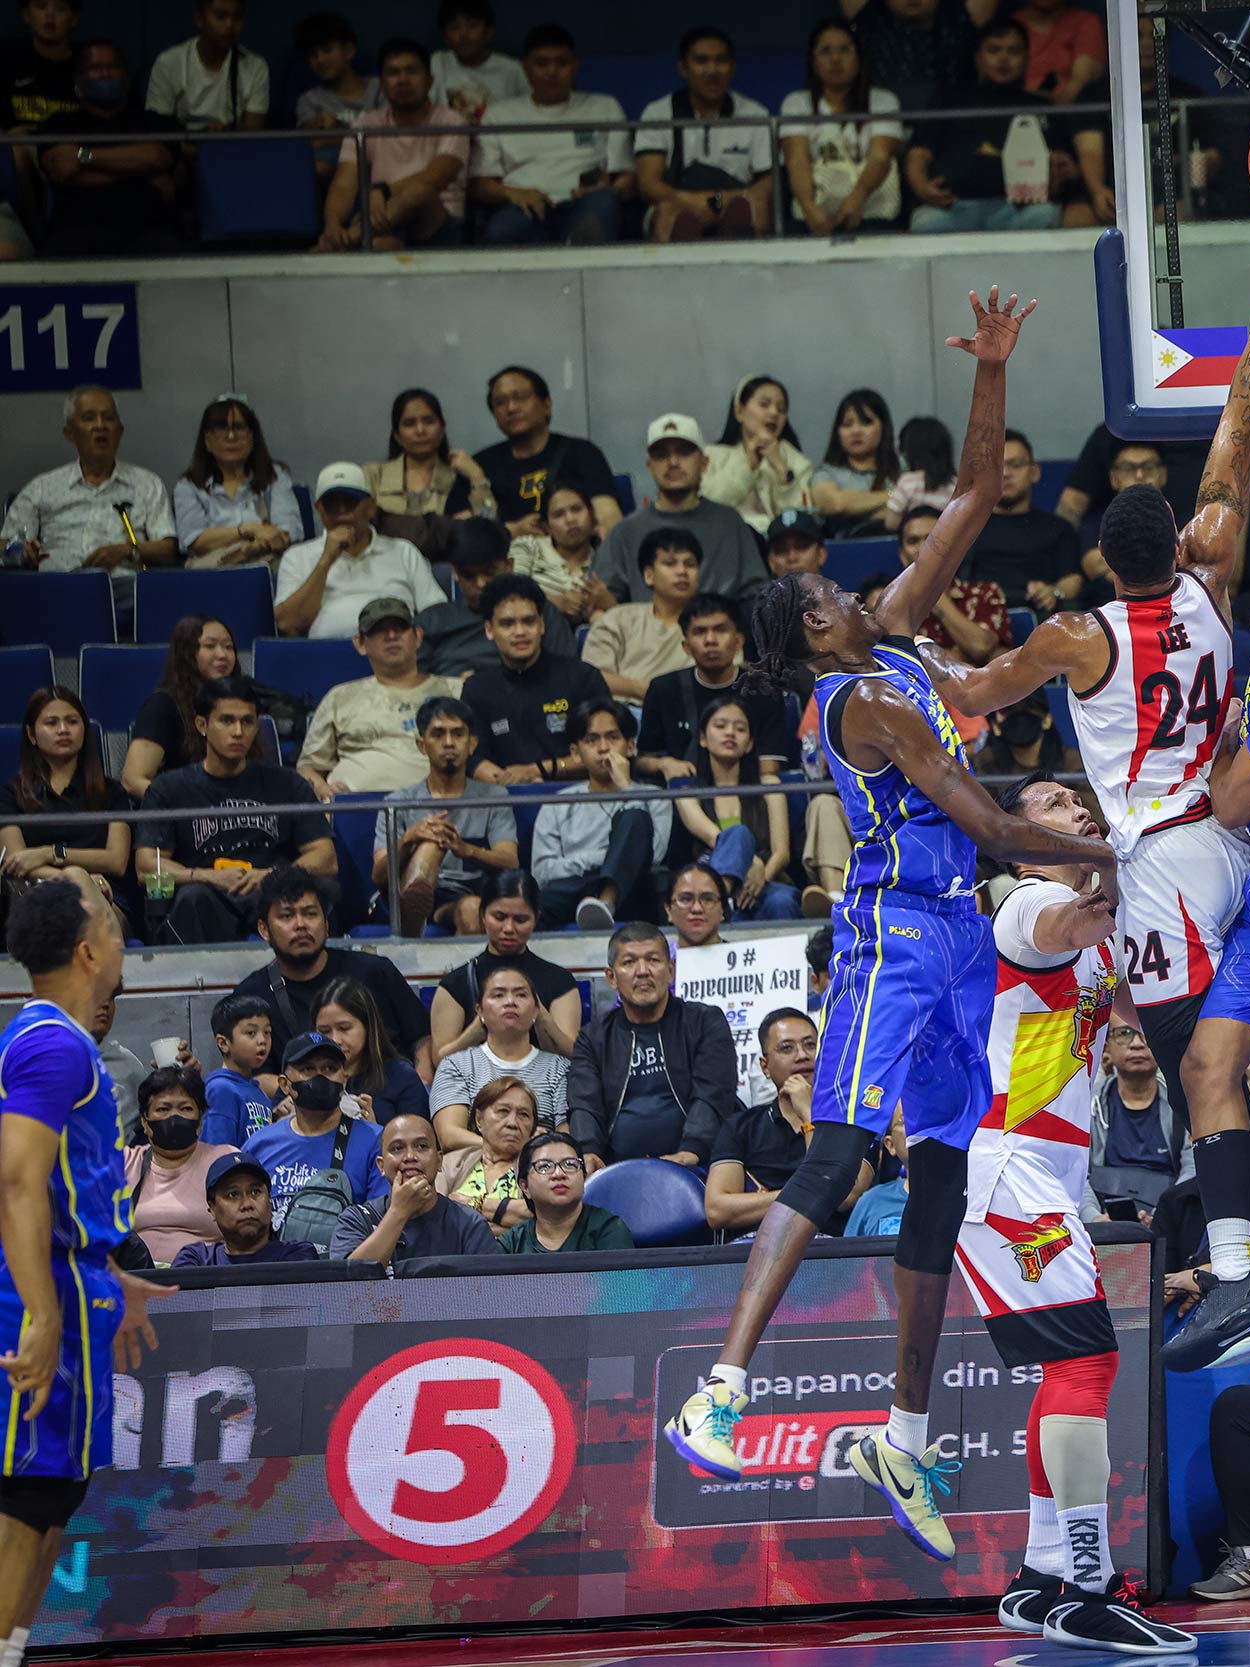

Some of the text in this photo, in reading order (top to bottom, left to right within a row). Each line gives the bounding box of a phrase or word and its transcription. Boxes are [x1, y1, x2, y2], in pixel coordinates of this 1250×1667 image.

[0, 303, 125, 371] 117
[1156, 622, 1192, 655] LEE
[1140, 650, 1222, 751] 24
[1124, 930, 1171, 985] 24
[681, 968, 800, 1000] Rey Nambatac
[943, 1361, 999, 1388] din
[1011, 1364, 1044, 1385] sa
[391, 1378, 509, 1524] 5
[735, 1422, 819, 1468] ulit
[935, 1433, 1000, 1458] CH.
[1067, 1518, 1102, 1583] KRKN
